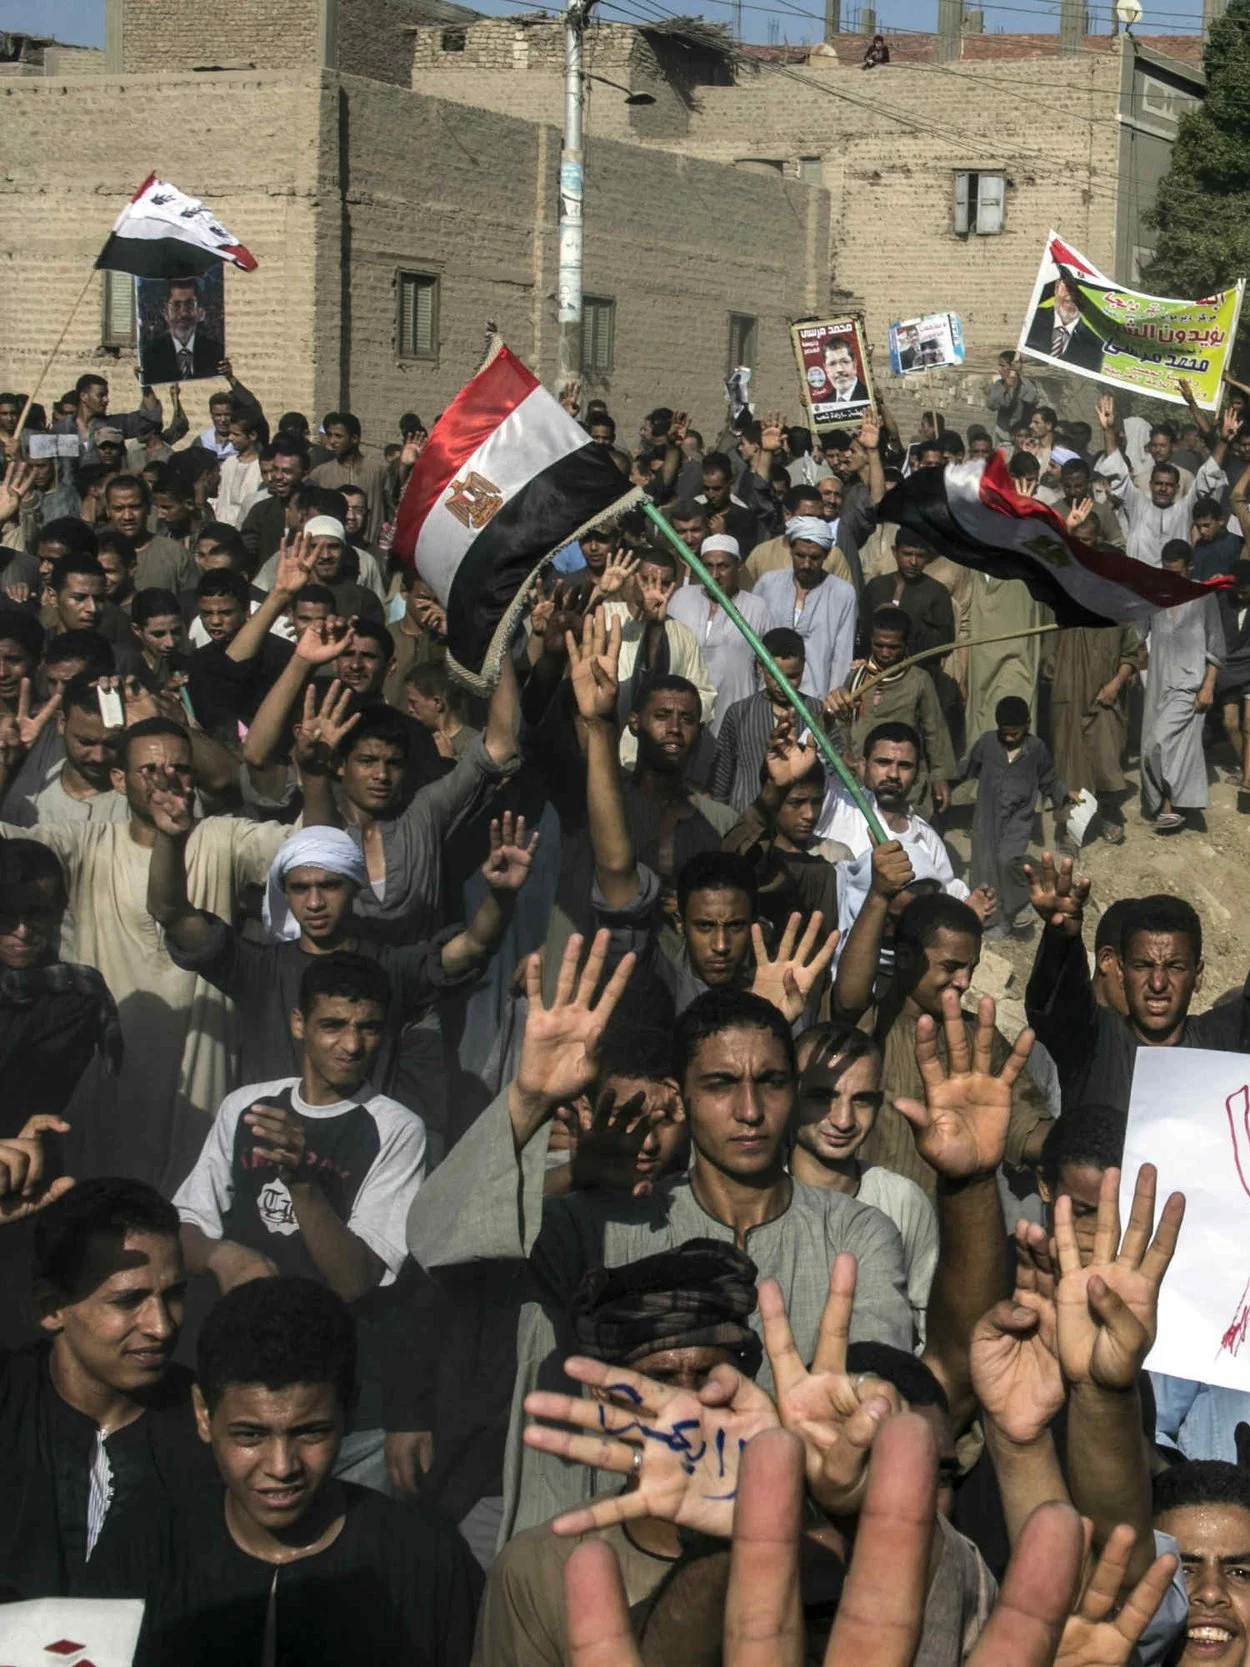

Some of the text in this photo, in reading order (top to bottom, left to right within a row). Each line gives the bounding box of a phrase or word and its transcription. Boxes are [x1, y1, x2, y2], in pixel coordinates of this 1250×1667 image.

[828, 323, 853, 335] محمد
[1158, 327, 1225, 346] يؤيدون
[1165, 354, 1209, 372] محمد
